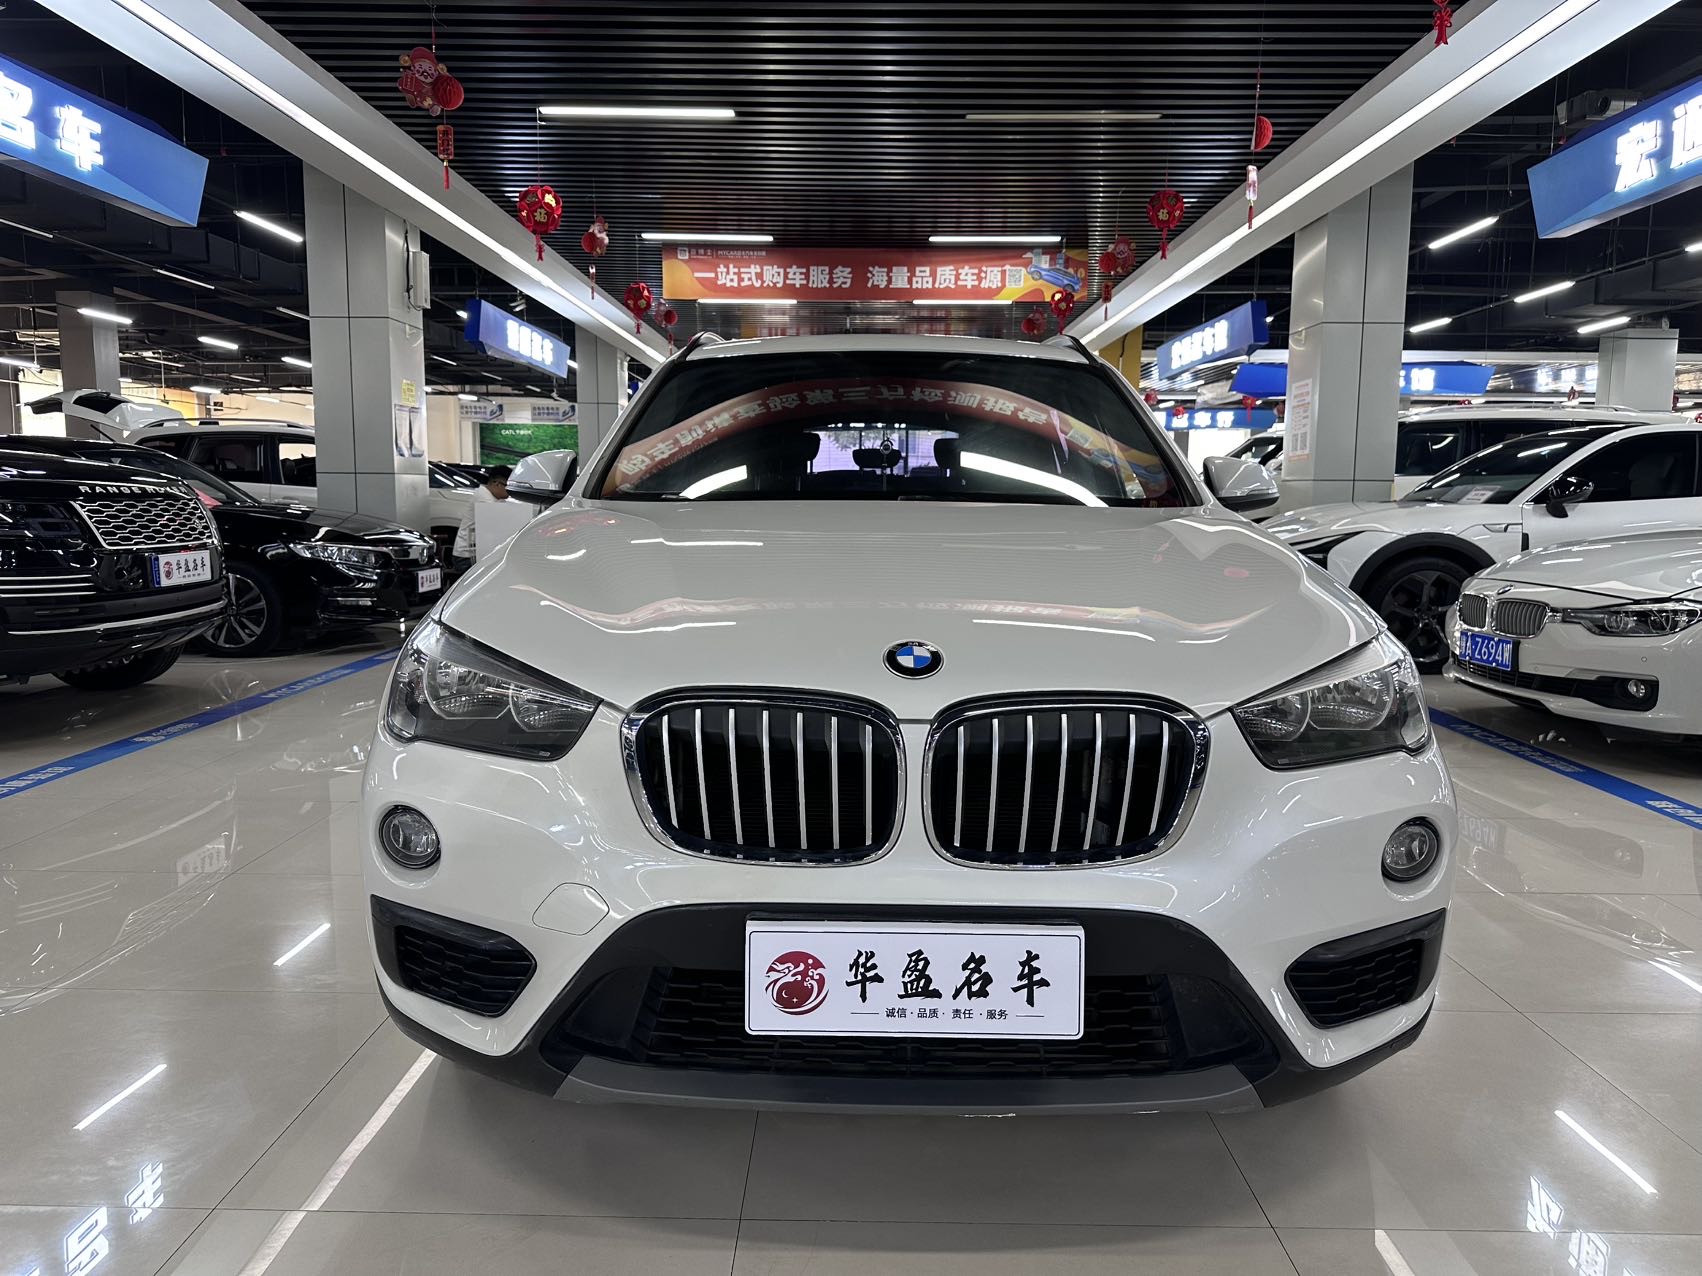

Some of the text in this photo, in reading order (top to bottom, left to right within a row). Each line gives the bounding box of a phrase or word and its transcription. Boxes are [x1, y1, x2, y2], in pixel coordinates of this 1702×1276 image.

[694, 264, 1002, 289] 一站式购车服务 海量品质车源
[79, 485, 142, 494] RANGE
[845, 949, 1051, 1008] 华盈名车
